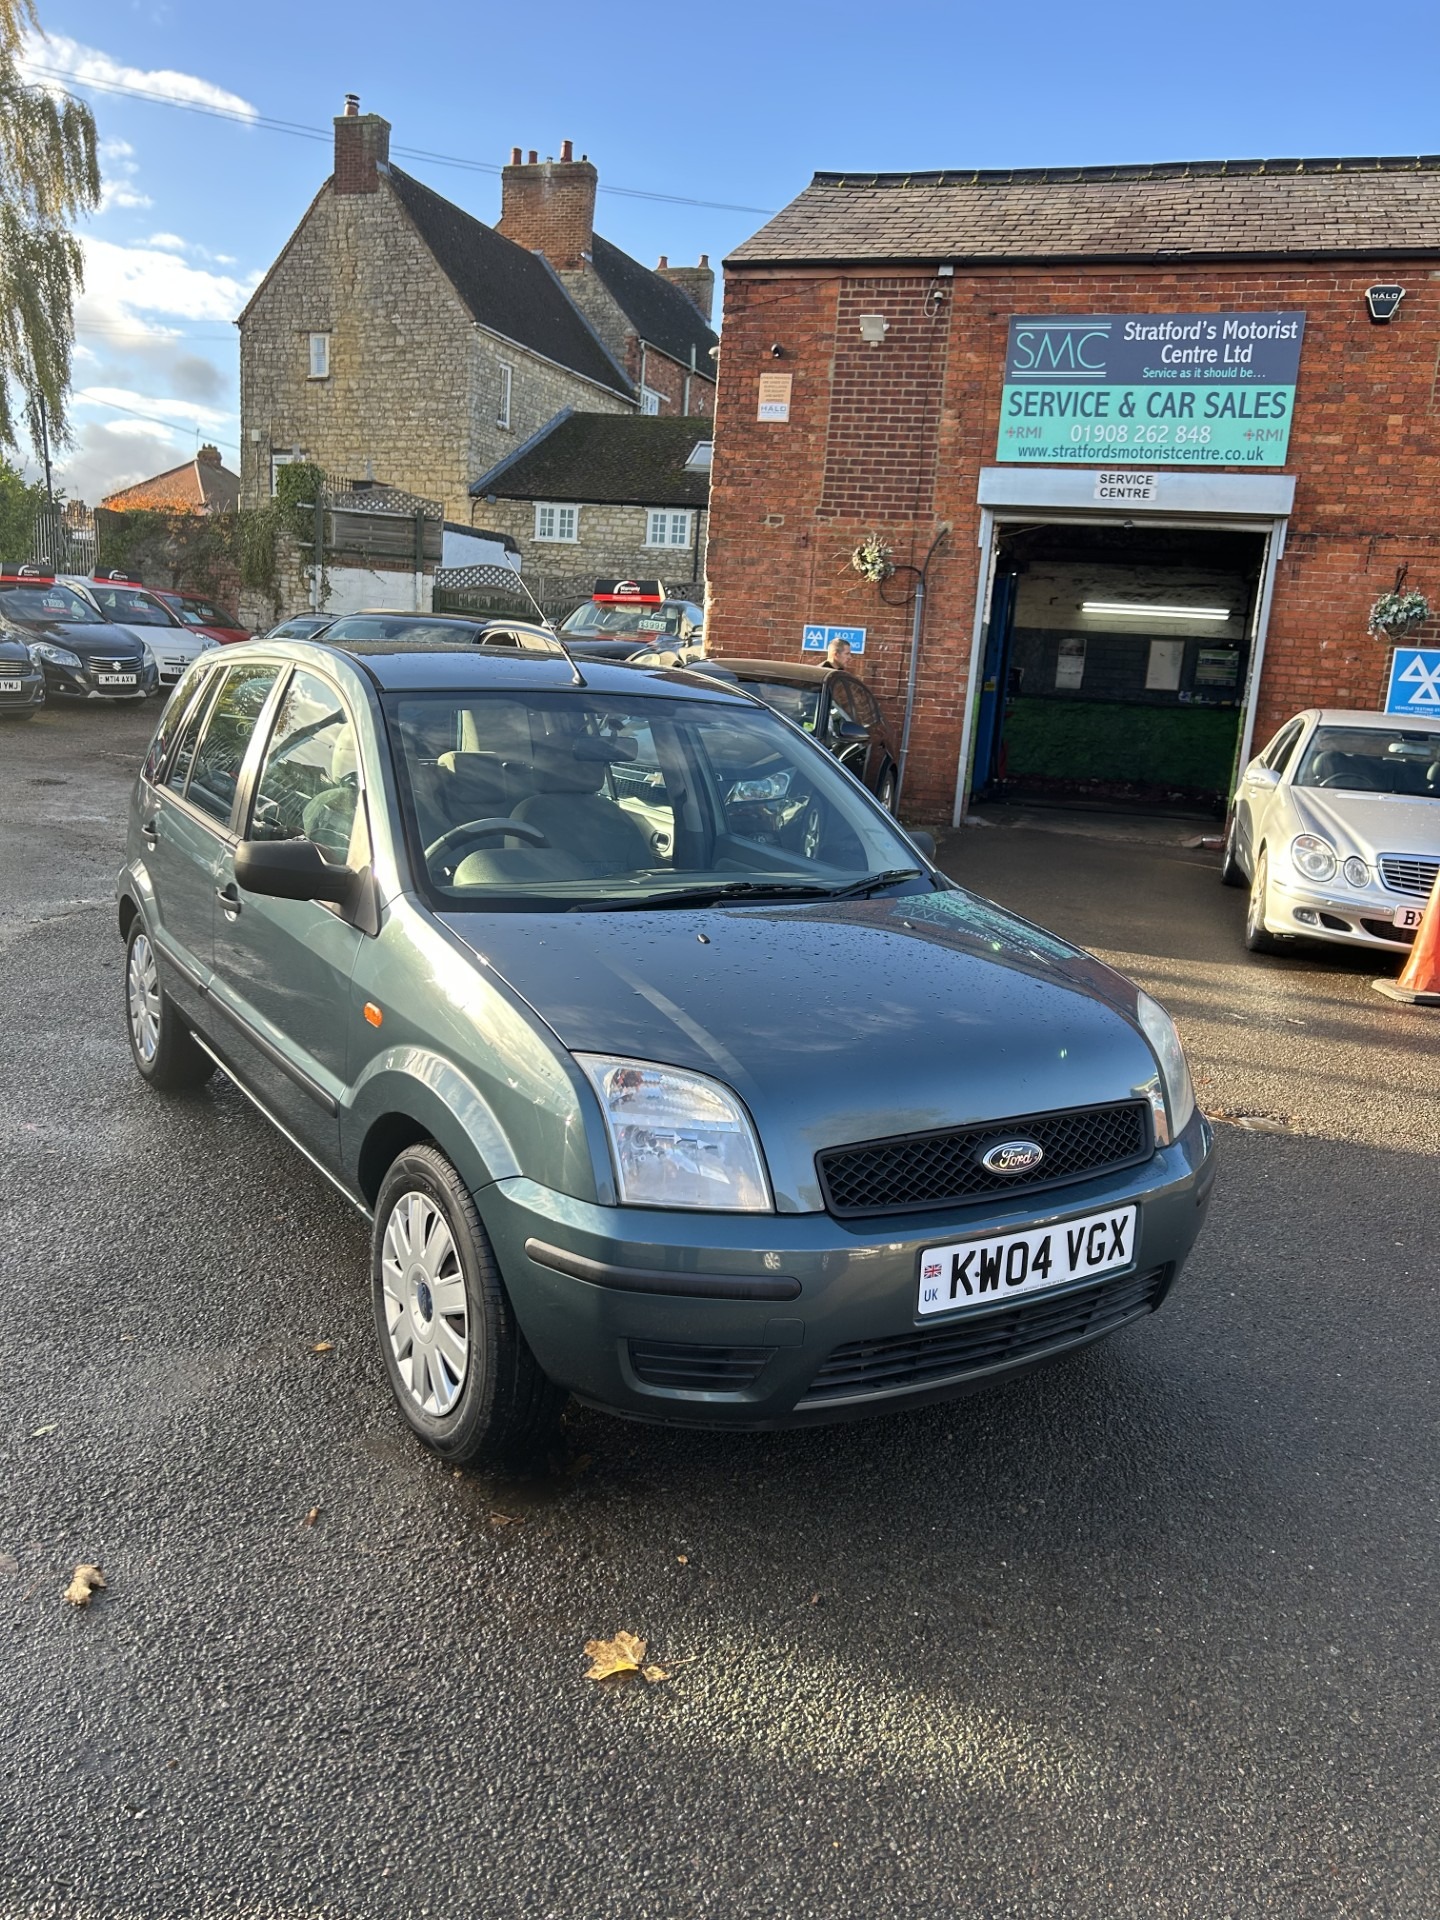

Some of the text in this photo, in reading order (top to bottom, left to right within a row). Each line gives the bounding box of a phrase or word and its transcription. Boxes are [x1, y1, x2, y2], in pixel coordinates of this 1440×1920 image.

[1124, 320, 1299, 341] Stratford's Motorist
[1014, 332, 1109, 369] SMC
[1161, 344, 1253, 364] Centre Ltd
[1142, 367, 1177, 378] Service
[1179, 369, 1191, 378] as
[1193, 367, 1202, 378] it
[1203, 367, 1238, 378] should
[1008, 391, 1287, 419] SERVICE & CAR SALES
[1016, 426, 1042, 439] RMI
[1071, 424, 1211, 444] 01908 262 848
[1256, 428, 1283, 442] RMI
[1018, 444, 1264, 461] www.stratfordsmotoristcentre.co.uk
[1099, 474, 1153, 485] SERVICE
[1099, 487, 1150, 498] CENTRE
[999, 1147, 1032, 1168] Ford
[949, 1215, 1129, 1300] KW04 VGX
[924, 1287, 938, 1303] UK
